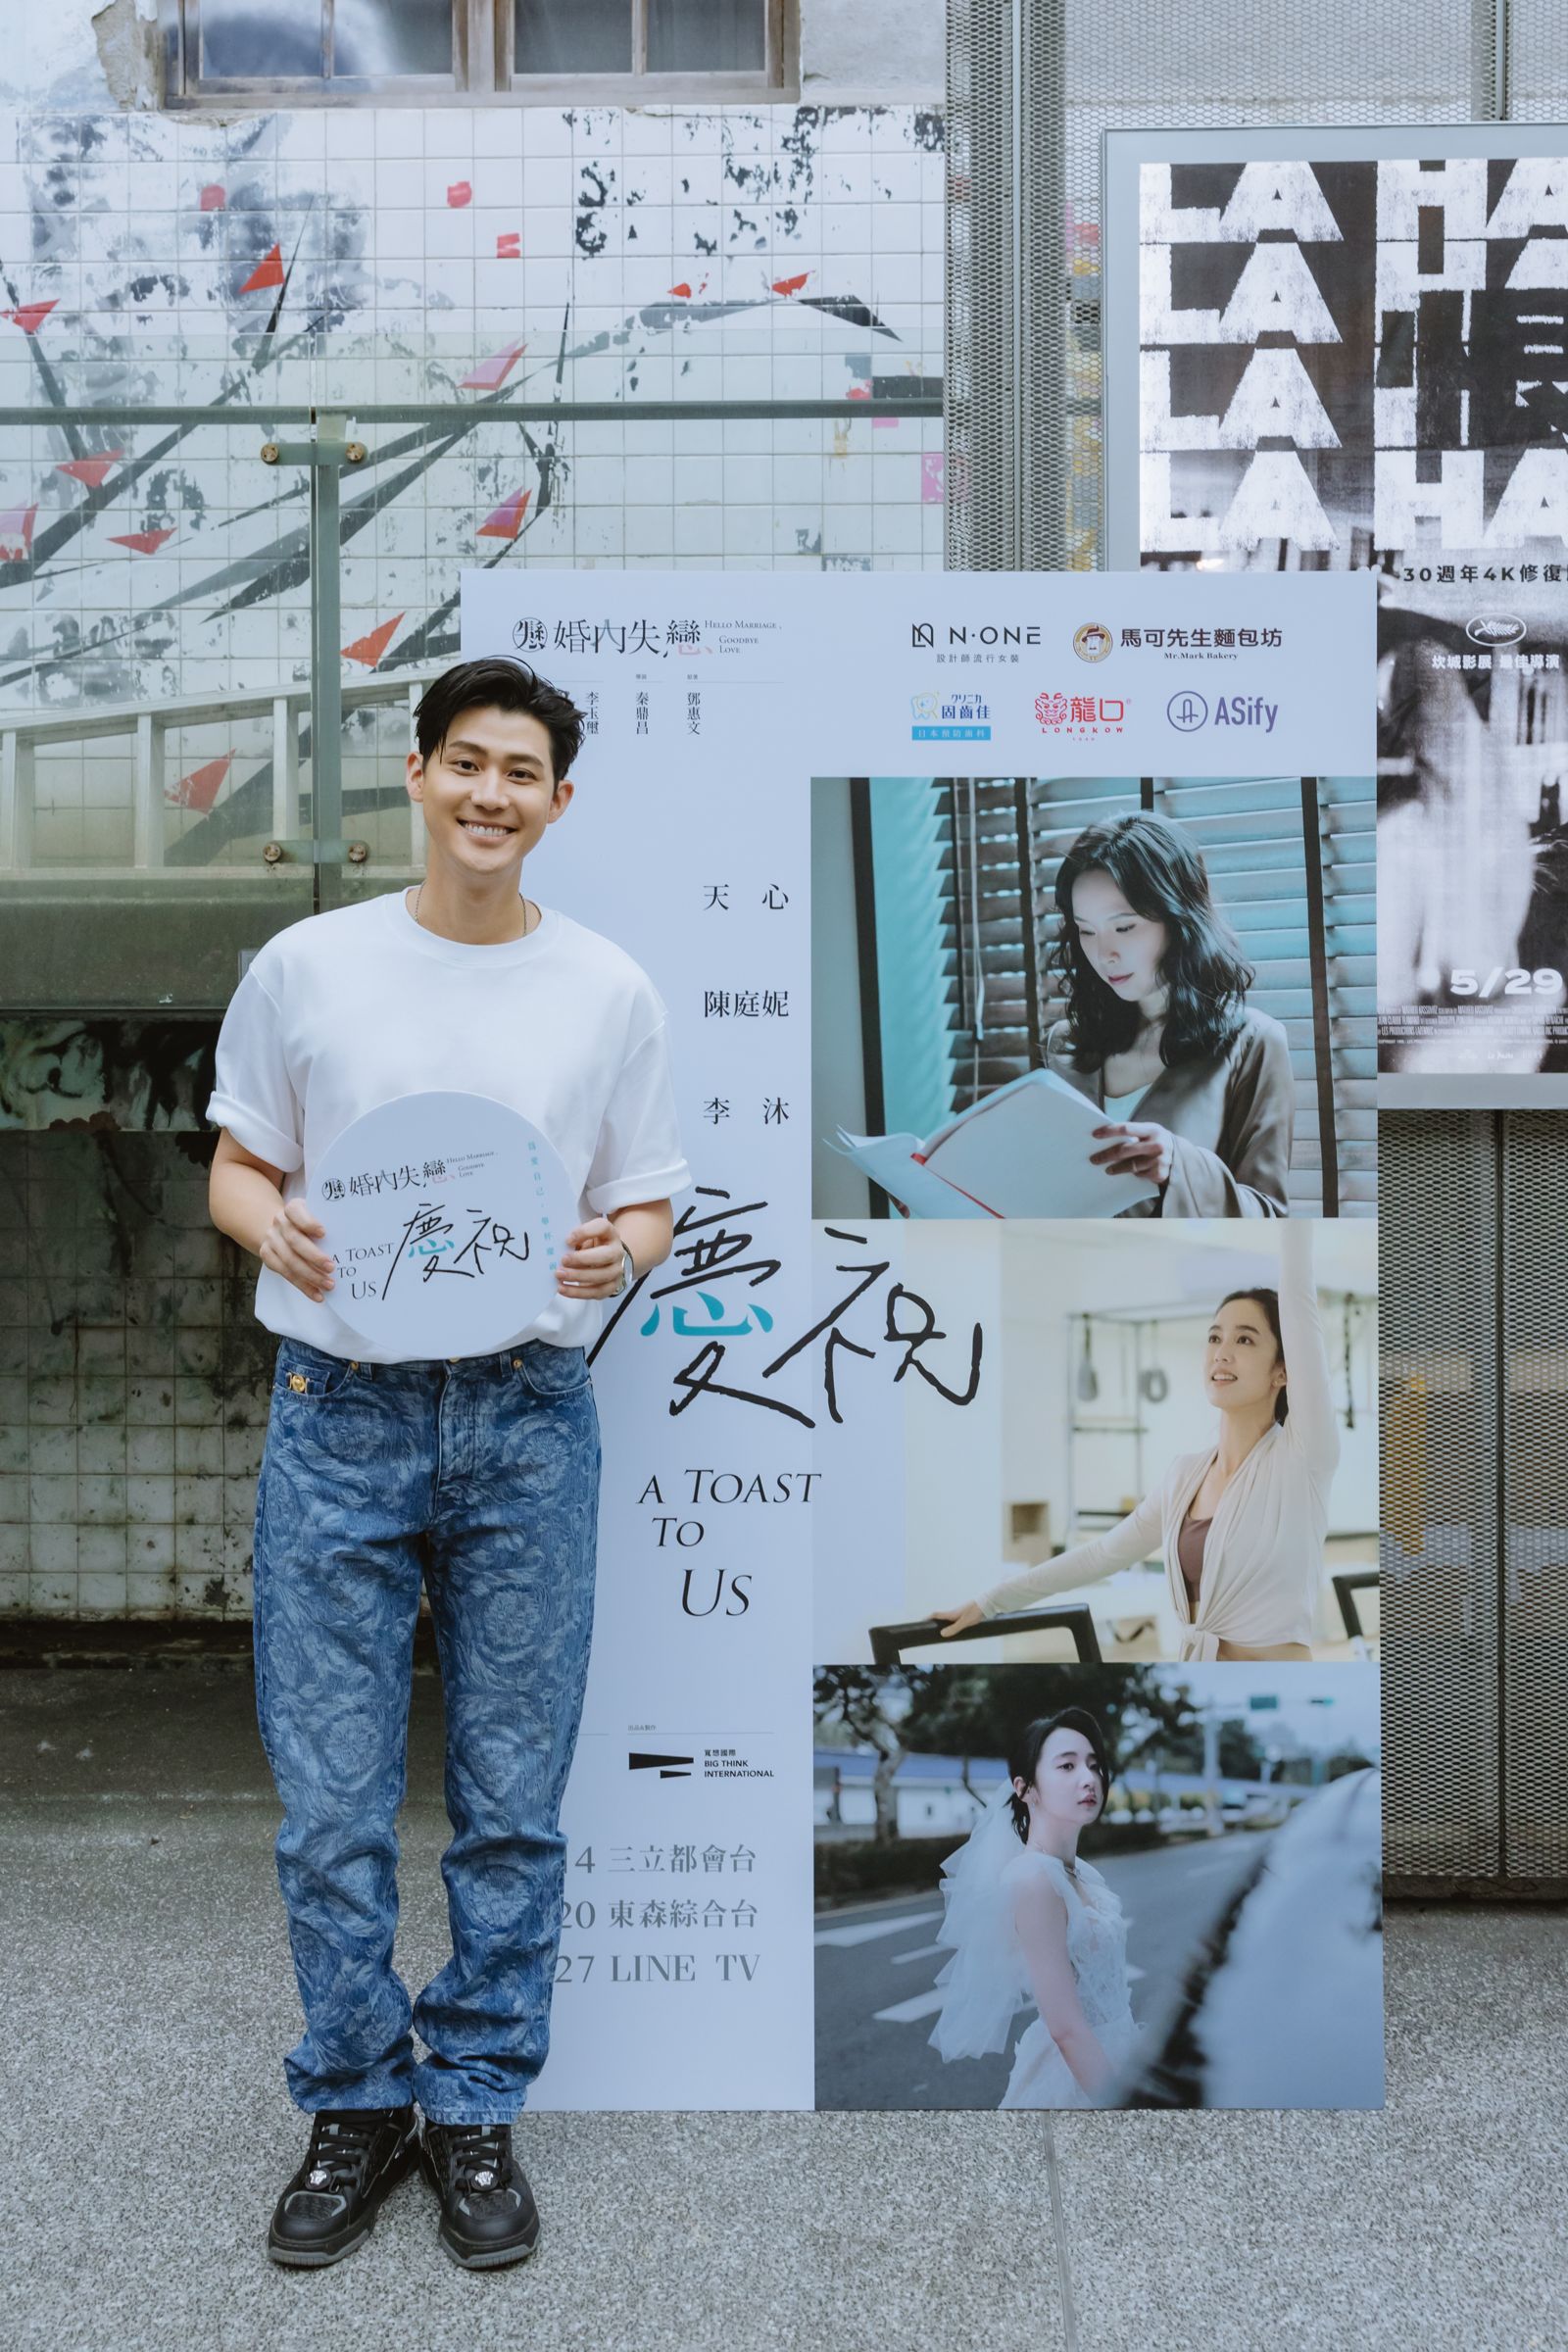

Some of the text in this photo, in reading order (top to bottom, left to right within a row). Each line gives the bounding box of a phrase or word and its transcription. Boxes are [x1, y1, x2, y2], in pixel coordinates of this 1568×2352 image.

[1140, 241, 1343, 344] LA
[1140, 348, 1343, 450] LA
[1140, 450, 1341, 552] LA
[1403, 564, 1568, 583] 30週年4K修復
[1120, 628, 1283, 648] 馬可先生麵包坊
[1432, 654, 1493, 669] 坎城影展
[635, 691, 649, 735] 秦鼎昌
[686, 691, 701, 735] 鄧惠文
[1214, 697, 1278, 733] ASify
[1450, 966, 1564, 998] 5/29
[704, 990, 790, 1018] 陳庭妮
[345, 1243, 395, 1262] TOAST
[336, 1266, 357, 1279] TO
[351, 1281, 377, 1300] US
[636, 1469, 821, 1505] A TOAST
[652, 1517, 705, 1548] TO
[682, 1569, 753, 1617] US
[608, 1843, 757, 1874] 三立都會台
[608, 1898, 759, 1929] 東森綜合台
[611, 1954, 696, 1983] LINE
[715, 1954, 760, 1983] TV
